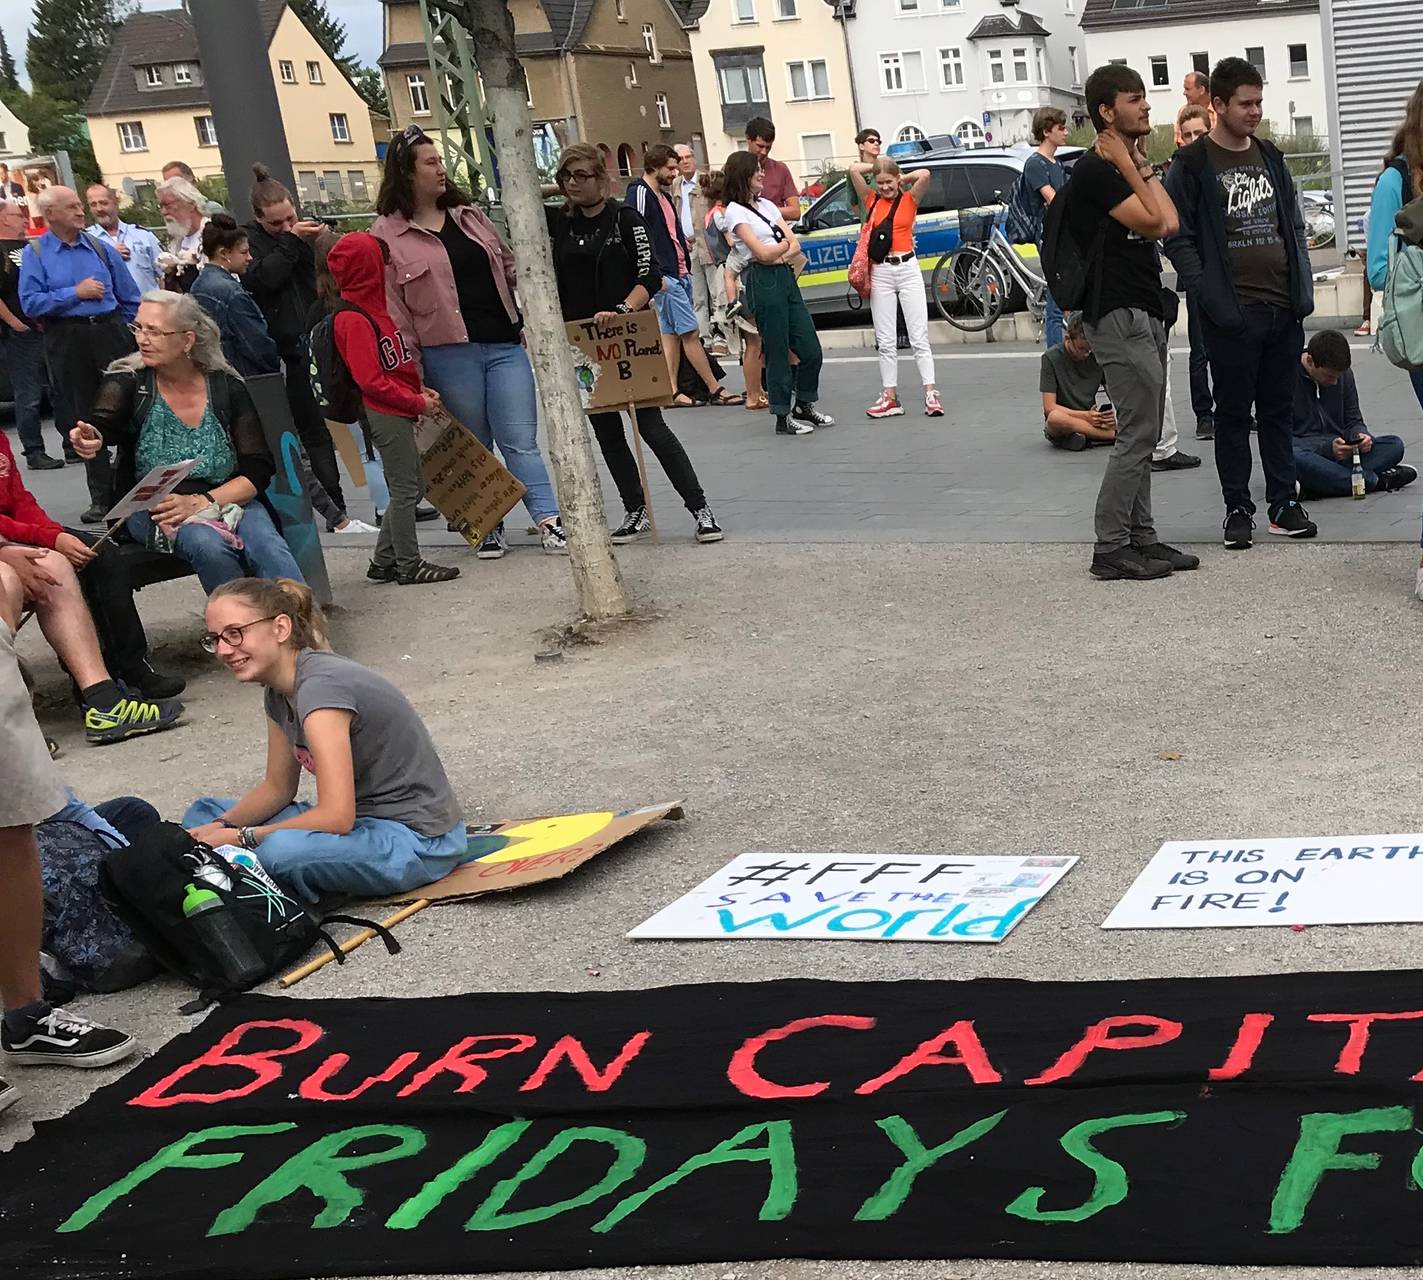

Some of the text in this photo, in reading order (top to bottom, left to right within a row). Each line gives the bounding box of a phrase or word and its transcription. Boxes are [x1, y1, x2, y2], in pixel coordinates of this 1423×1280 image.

[1227, 174, 1274, 215] Lights
[807, 244, 850, 266] LIZEI
[579, 322, 637, 340] There is
[596, 338, 662, 360] NO Planet
[617, 360, 632, 380] B
[1181, 849, 1265, 864] THIS
[728, 860, 976, 887] #FFF
[1167, 868, 1305, 886] IS ON
[705, 891, 876, 908] SAVE
[886, 891, 961, 904] THE
[1151, 891, 1290, 913] FIRE!
[126, 1018, 653, 1108] BURN
[56, 1109, 1189, 1237] FRIDAYS
